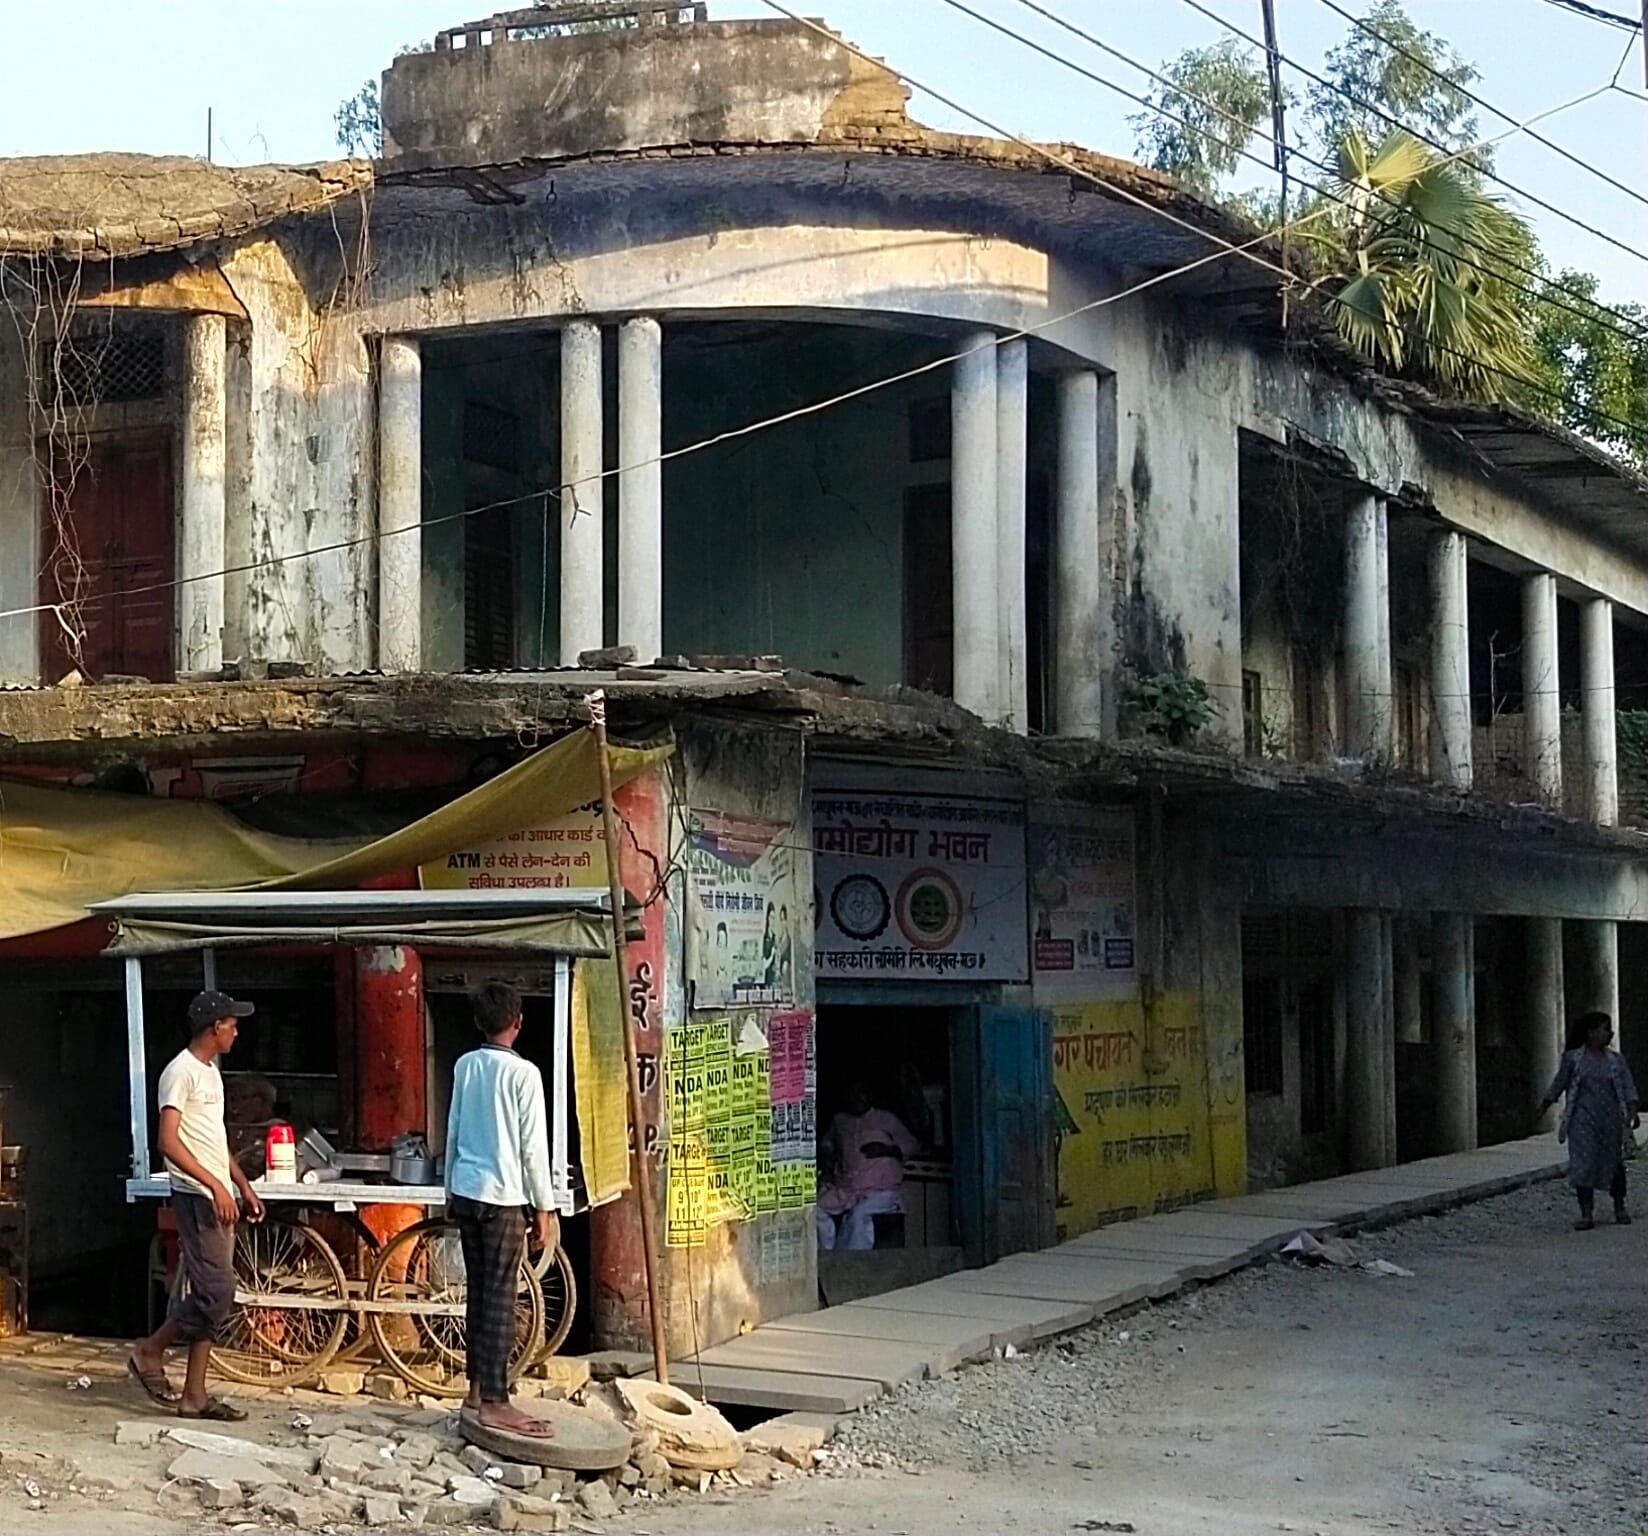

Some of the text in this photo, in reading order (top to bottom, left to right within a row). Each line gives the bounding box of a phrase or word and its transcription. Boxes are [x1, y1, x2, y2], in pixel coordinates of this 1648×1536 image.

[929, 830, 991, 863] भवन
[447, 851, 591, 868] ATM से पैसे लेन-देन की
[671, 1028, 705, 1049] TARGET
[732, 1062, 754, 1079] NDA
[757, 1058, 770, 1073] ND
[674, 1075, 704, 1095] NDA
[707, 1068, 728, 1087] NDA
[706, 1126, 729, 1145] TARGET
[707, 1172, 729, 1191] NDA
